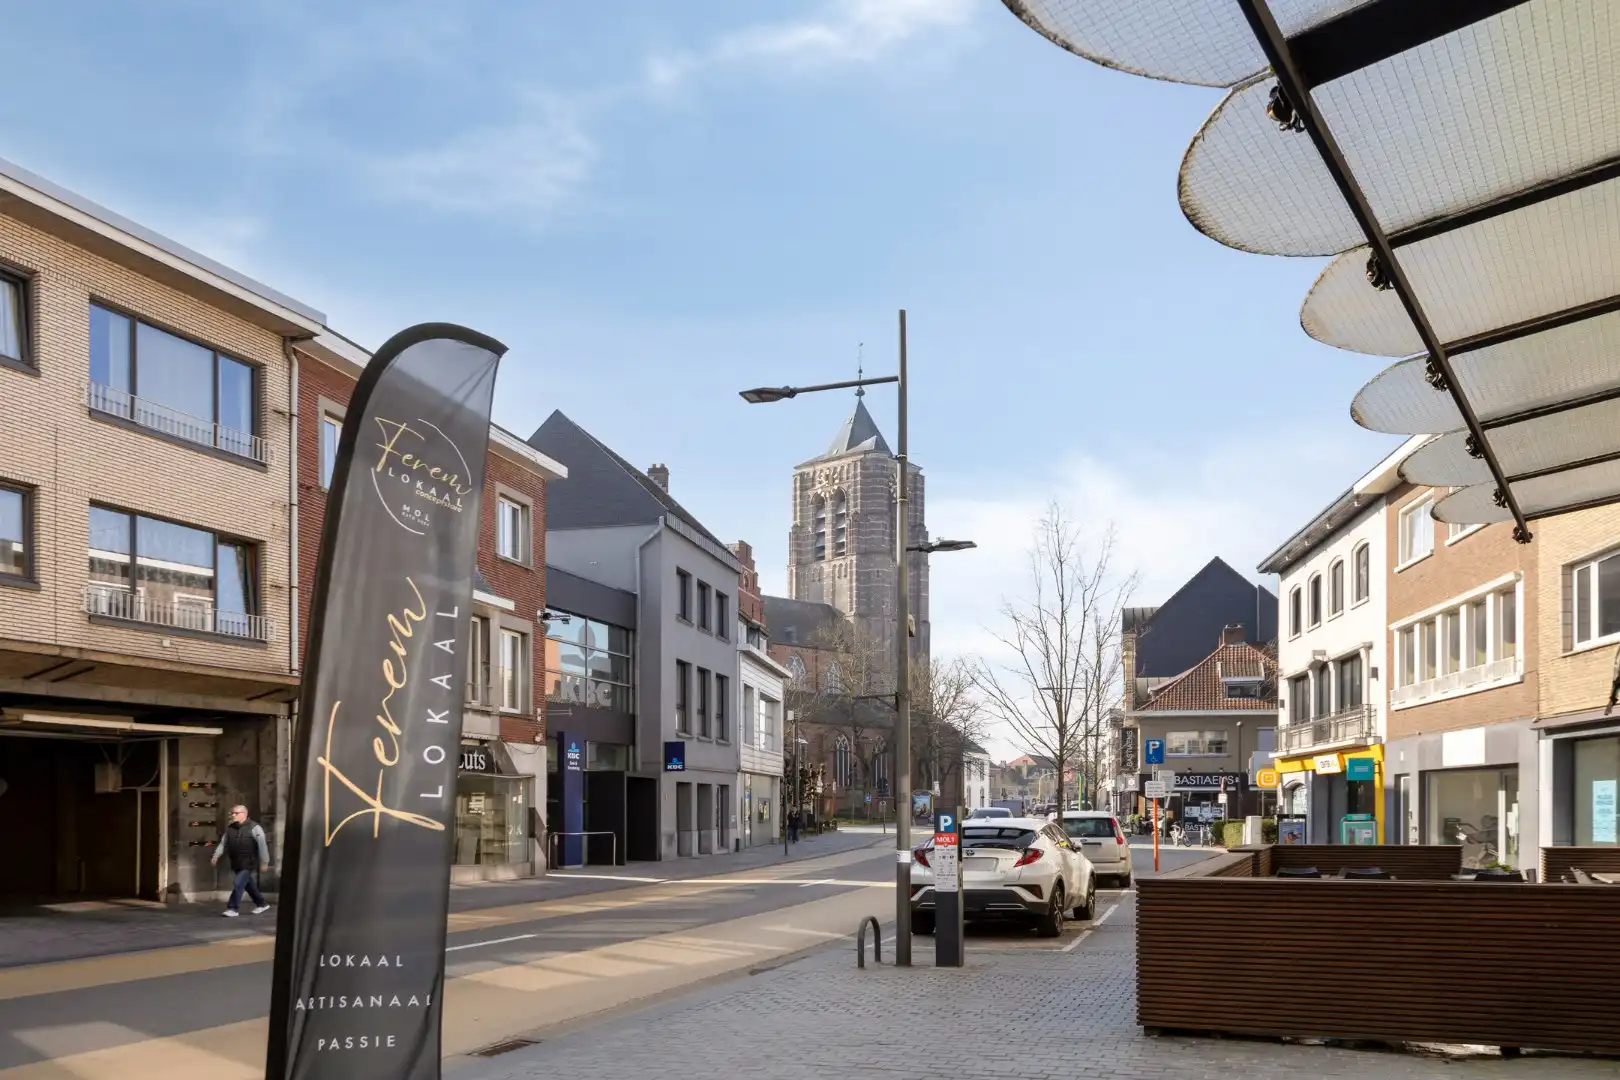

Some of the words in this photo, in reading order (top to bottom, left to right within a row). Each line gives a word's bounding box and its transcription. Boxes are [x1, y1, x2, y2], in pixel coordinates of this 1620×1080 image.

[388, 467, 463, 508] LOKAAL
[415, 489, 463, 513] conceptstore
[402, 504, 431, 522] MOL
[420, 605, 459, 799] LOKAAL
[567, 752, 580, 760] KBC
[1149, 740, 1160, 755] P
[940, 815, 952, 832] P
[320, 954, 404, 968] LOKAAL
[295, 995, 432, 1010] ARTISANAAL
[318, 1035, 397, 1052] PASSIE
